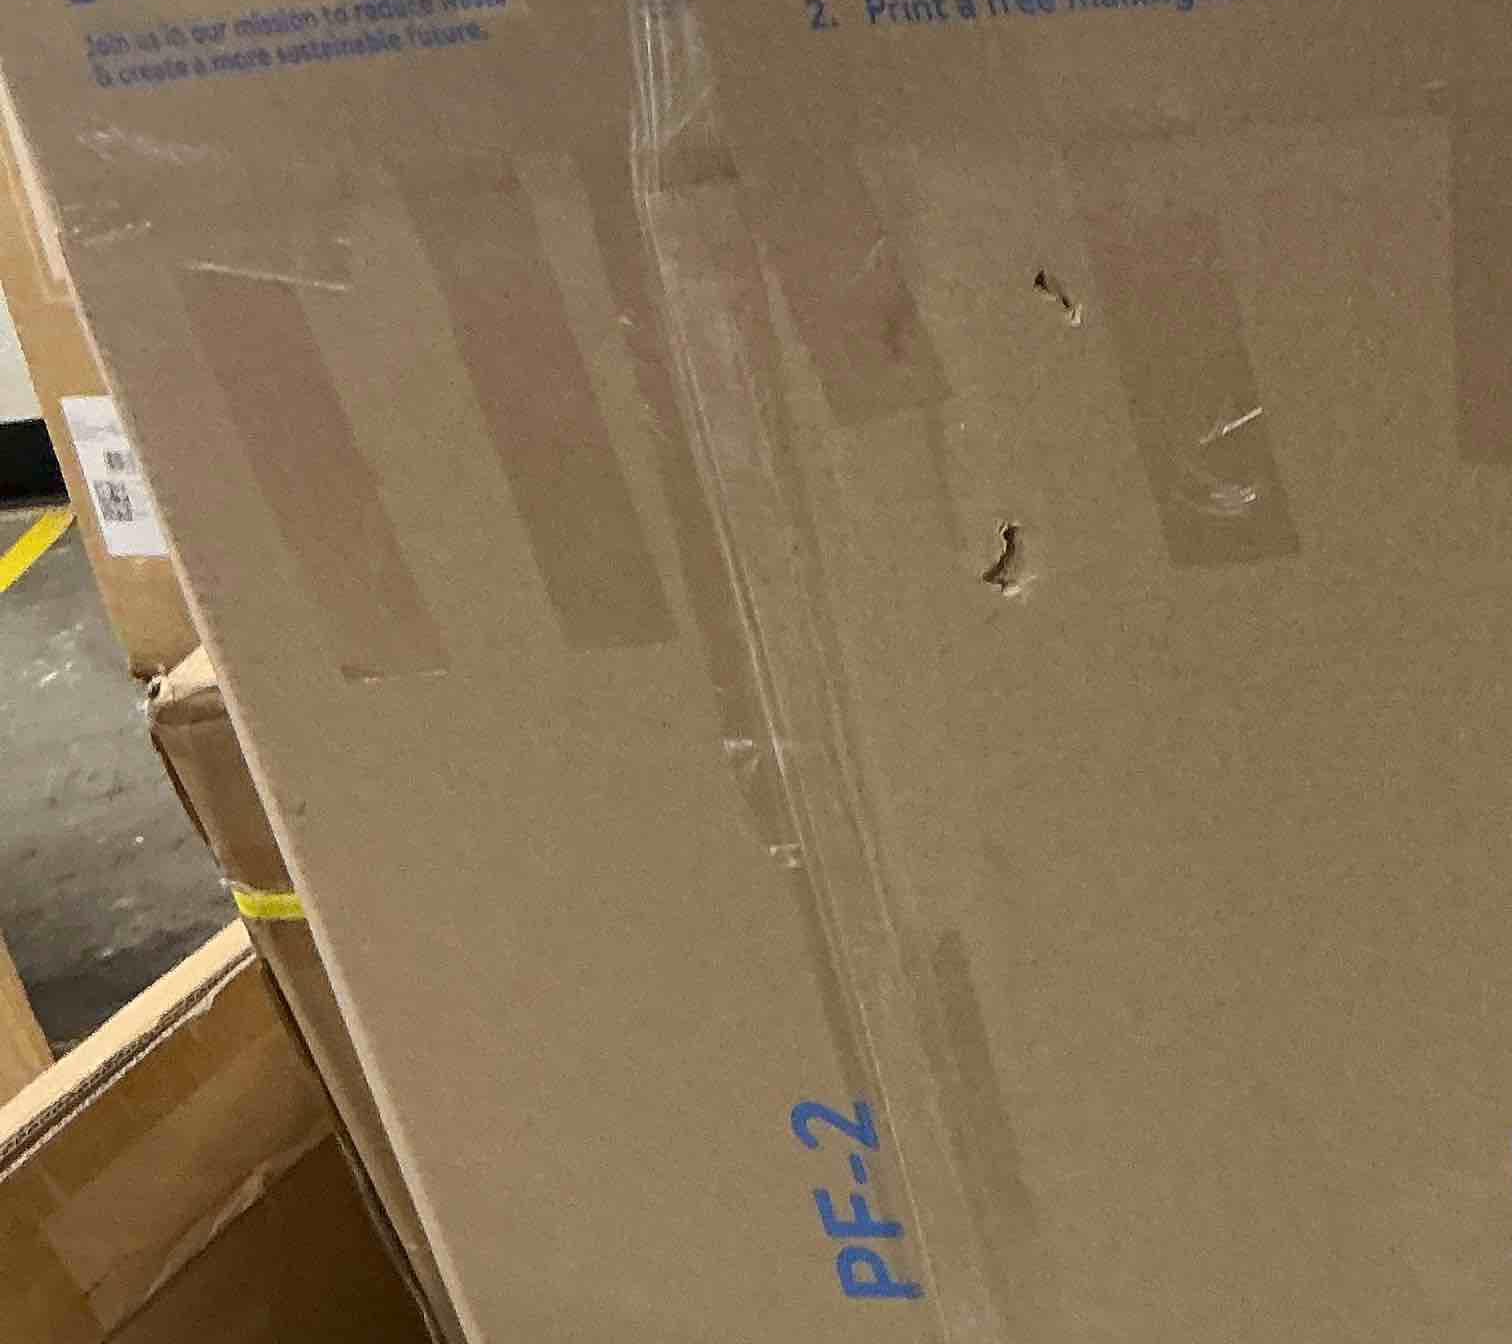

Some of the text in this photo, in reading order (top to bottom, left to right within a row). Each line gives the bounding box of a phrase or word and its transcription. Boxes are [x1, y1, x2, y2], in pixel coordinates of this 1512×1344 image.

[192, 19, 226, 44] our
[235, 10, 316, 36] mission
[322, 3, 347, 24] to
[119, 61, 189, 84] create
[212, 48, 273, 71] more
[278, 30, 401, 65] sustainable
[790, 1102, 926, 1299] PF-2
